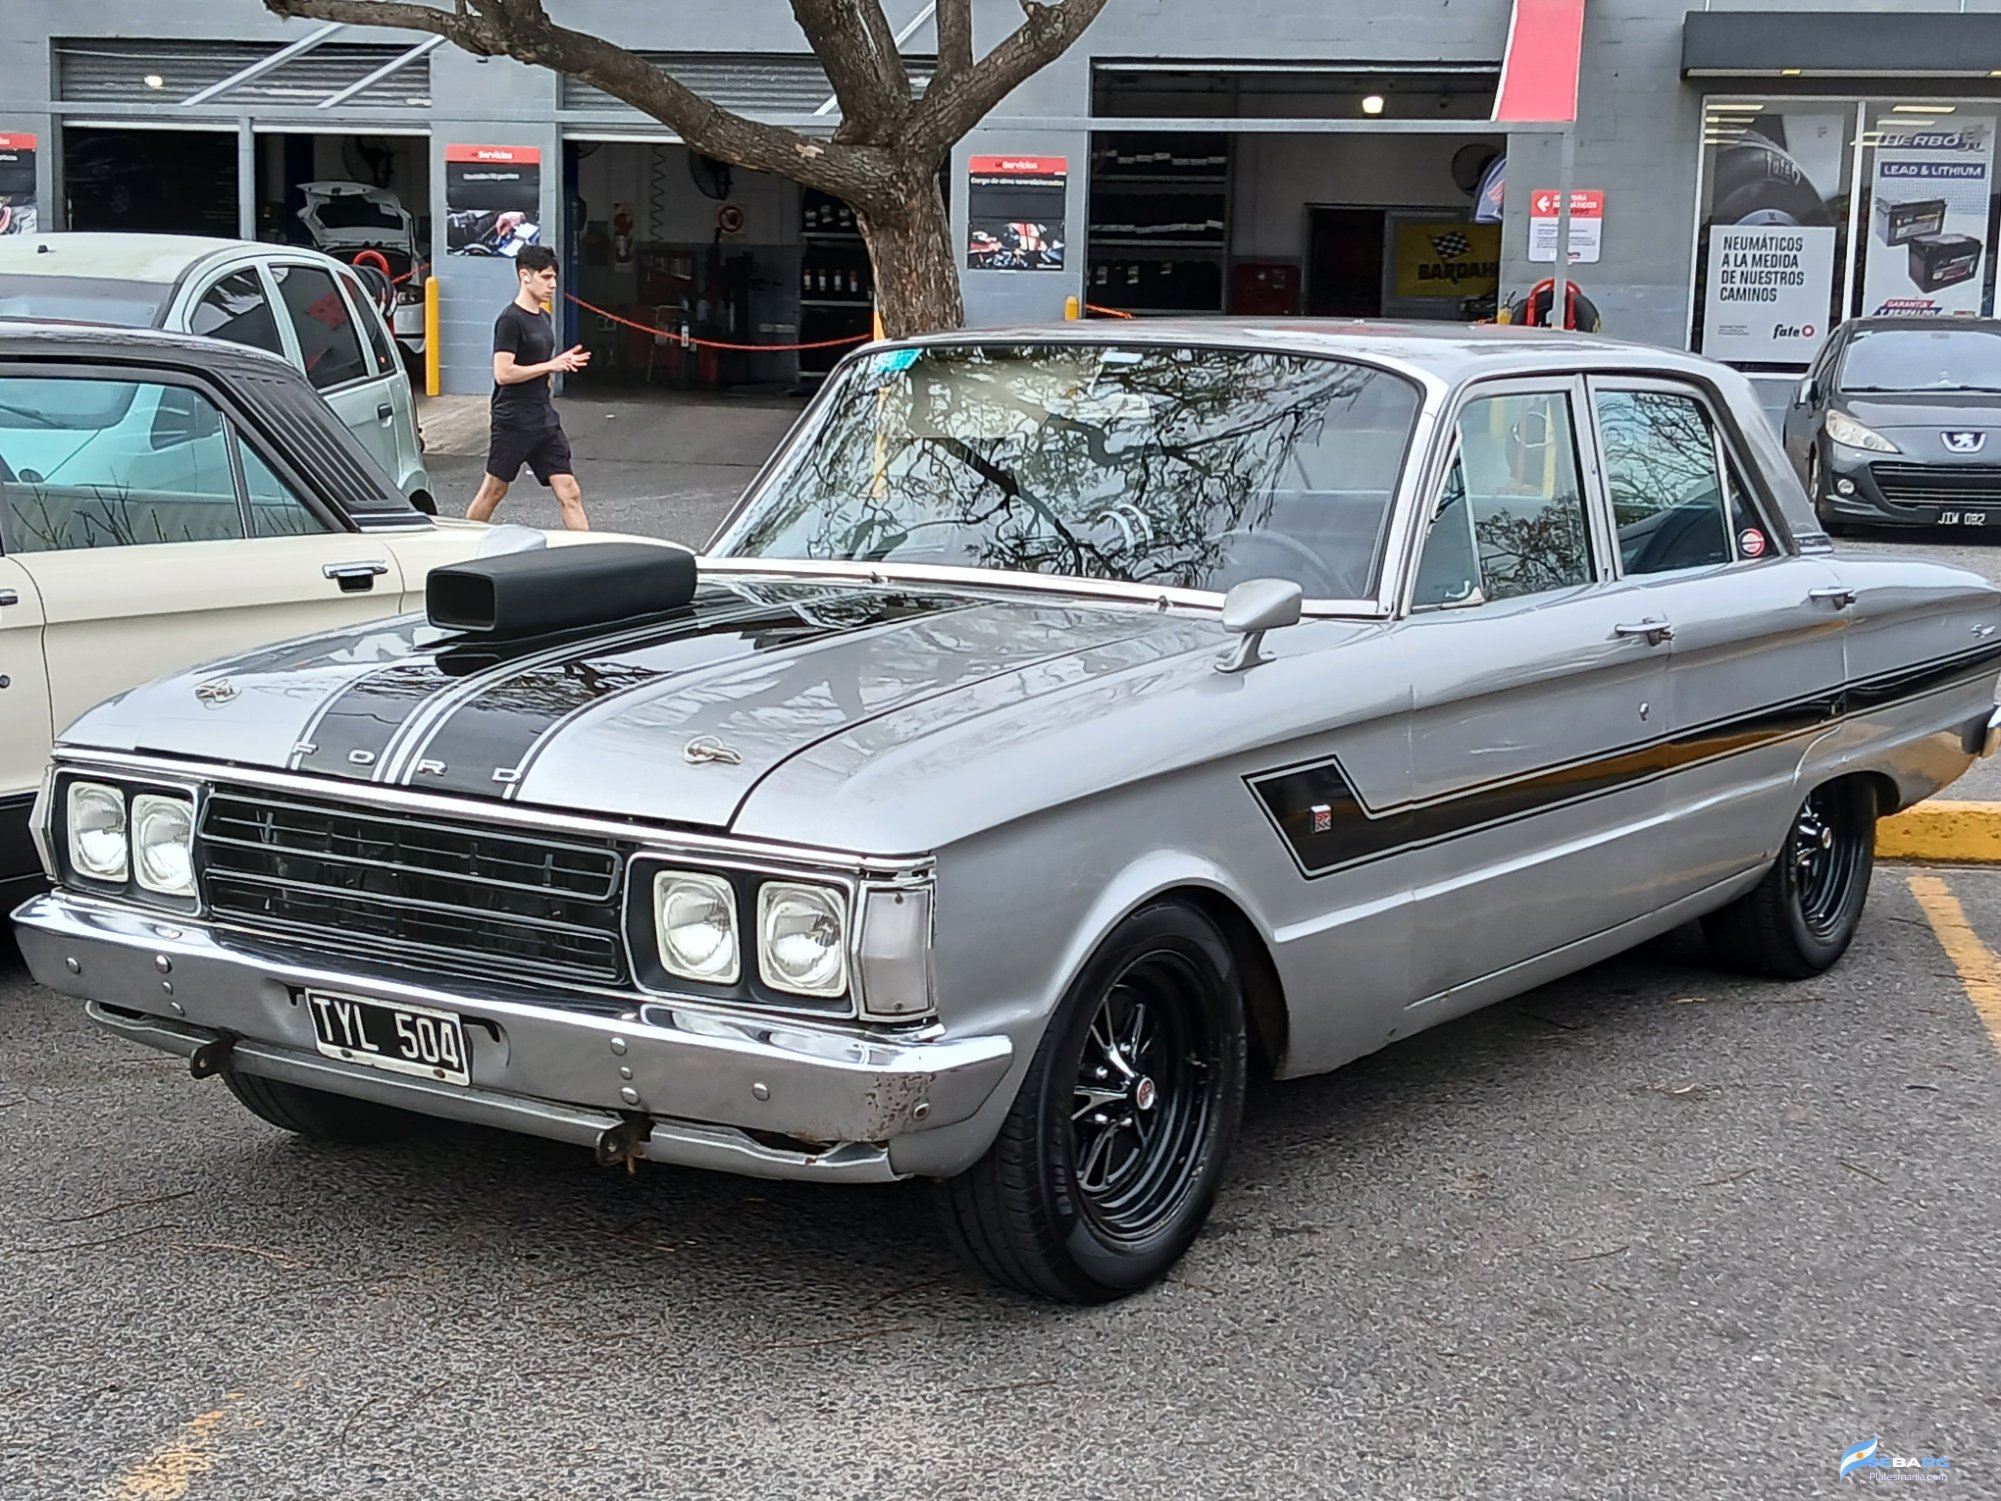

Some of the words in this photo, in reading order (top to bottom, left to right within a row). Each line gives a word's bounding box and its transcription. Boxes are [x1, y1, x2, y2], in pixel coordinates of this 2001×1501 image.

[1884, 165, 1918, 175] LEAD
[1920, 165, 1930, 175] &
[1932, 165, 1982, 176] LITHIUM
[1723, 233, 1803, 252] NEUMÁTICOS
[1721, 253, 1730, 268] A
[1733, 254, 1748, 268] LA
[1751, 254, 1799, 269] MEDIDA
[1721, 270, 1736, 284] DE
[1739, 271, 1805, 286] NUESTROS
[1720, 287, 1777, 302] CAMINOS
[291, 741, 522, 784] FORD
[313, 997, 380, 1052] TYL
[394, 1012, 460, 1069] 504
